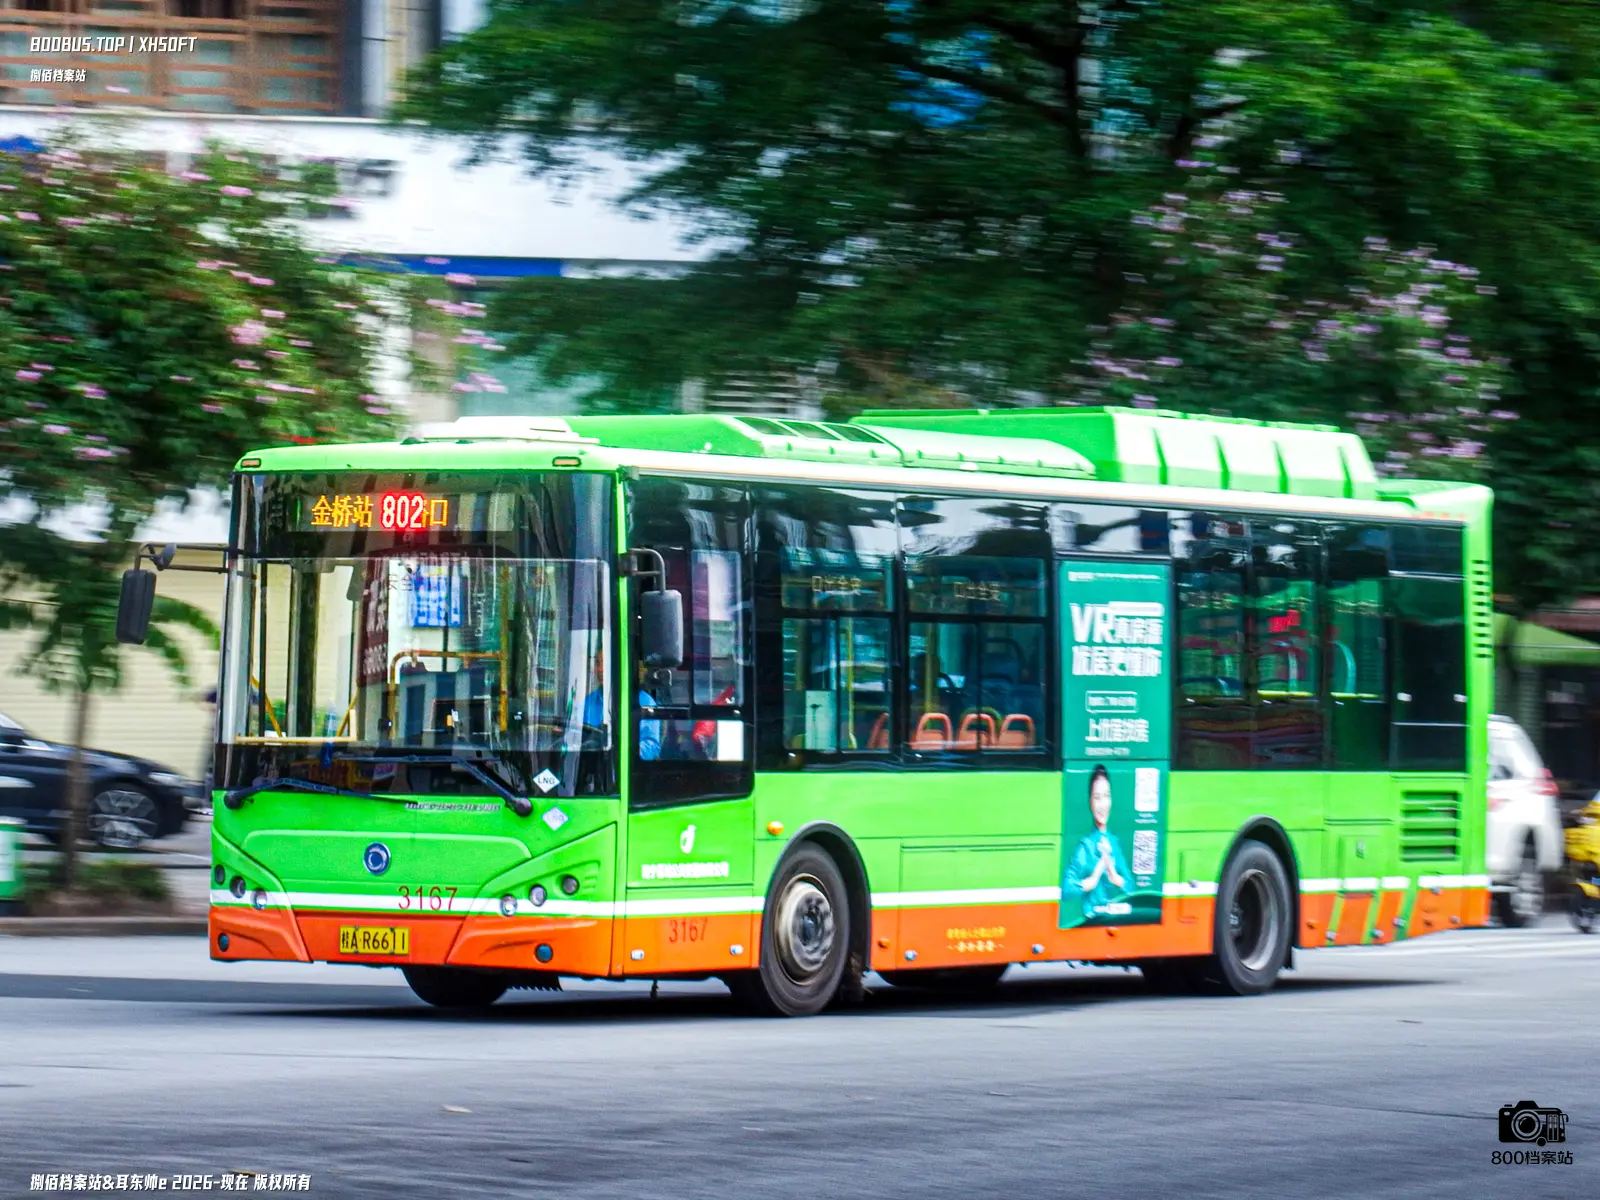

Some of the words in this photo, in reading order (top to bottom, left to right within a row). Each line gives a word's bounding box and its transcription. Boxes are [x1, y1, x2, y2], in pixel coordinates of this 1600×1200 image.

[310, 494, 374, 528] 金桥站
[381, 495, 424, 528] 802
[398, 885, 458, 911] 3167
[669, 916, 708, 943] 3167
